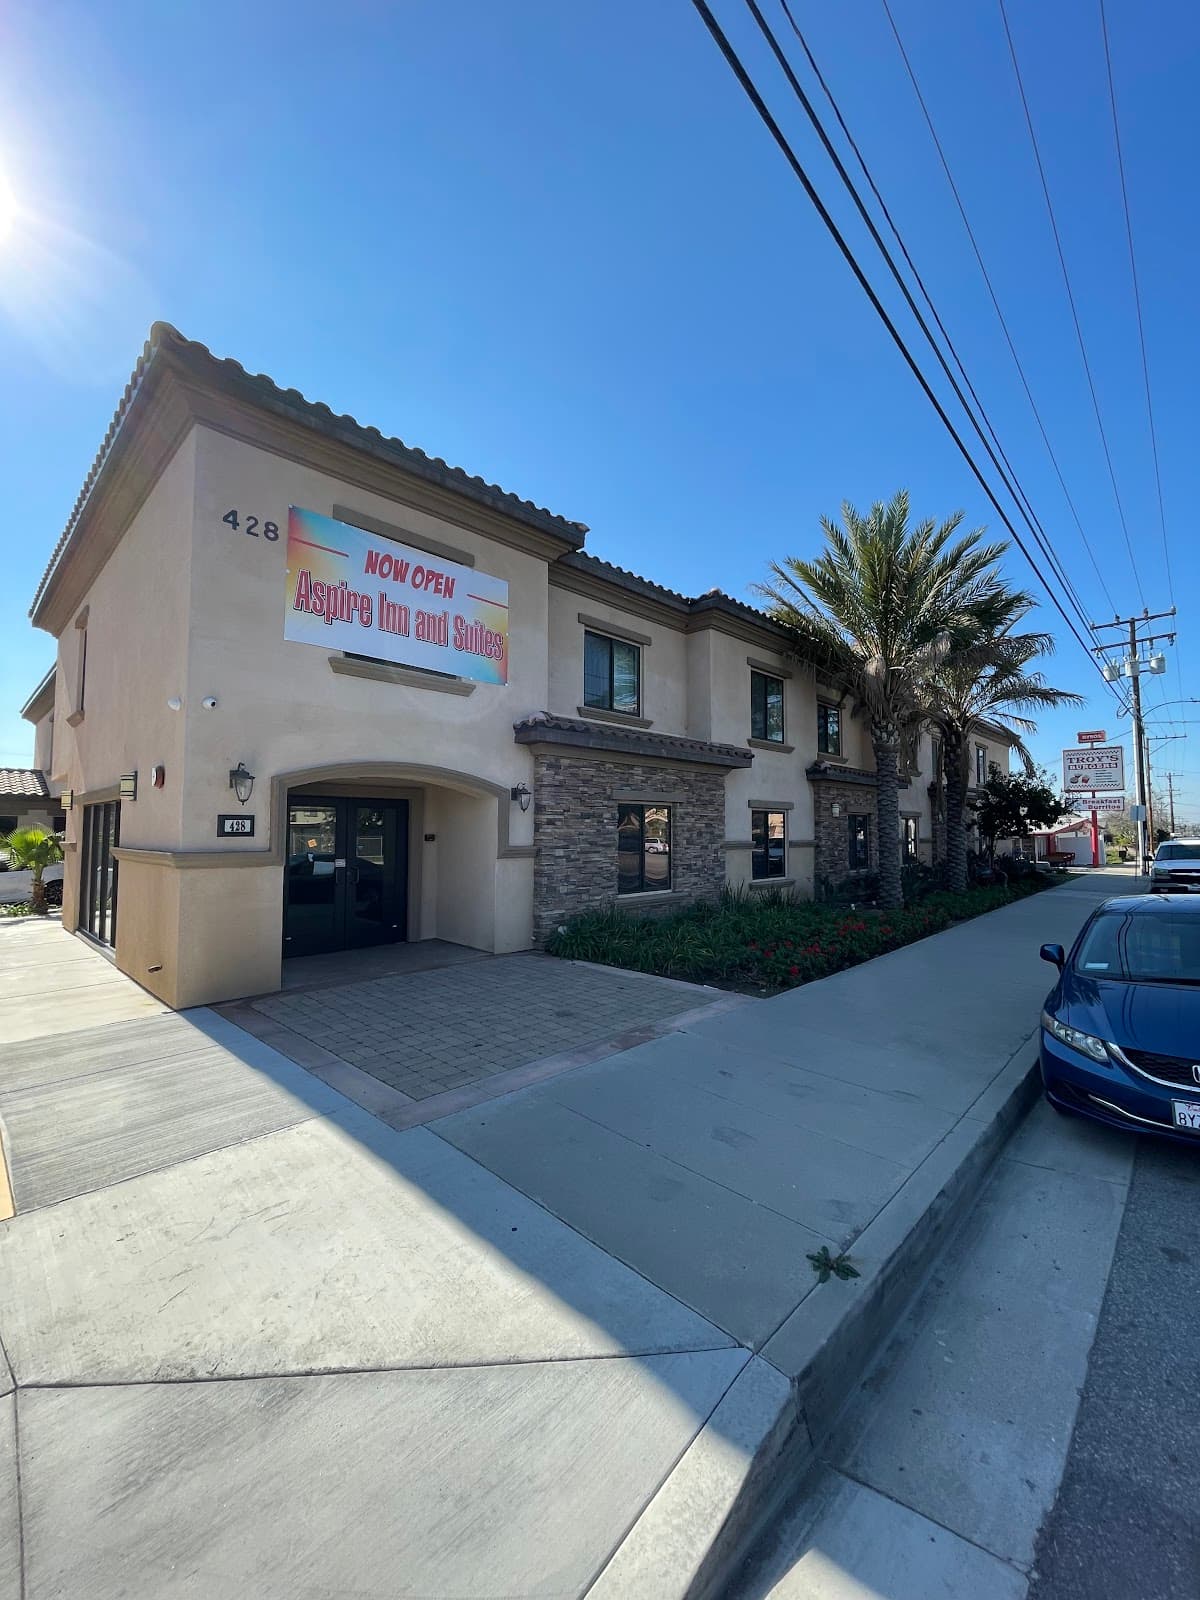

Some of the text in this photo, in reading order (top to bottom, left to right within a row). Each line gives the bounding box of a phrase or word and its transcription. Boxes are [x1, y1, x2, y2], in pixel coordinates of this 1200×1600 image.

[222, 509, 279, 542] 428
[364, 549, 456, 599] NOW OPEN
[293, 569, 504, 661] Aspire Inn and Suites
[1066, 755, 1119, 763] TROY'S
[229, 820, 246, 832] 428
